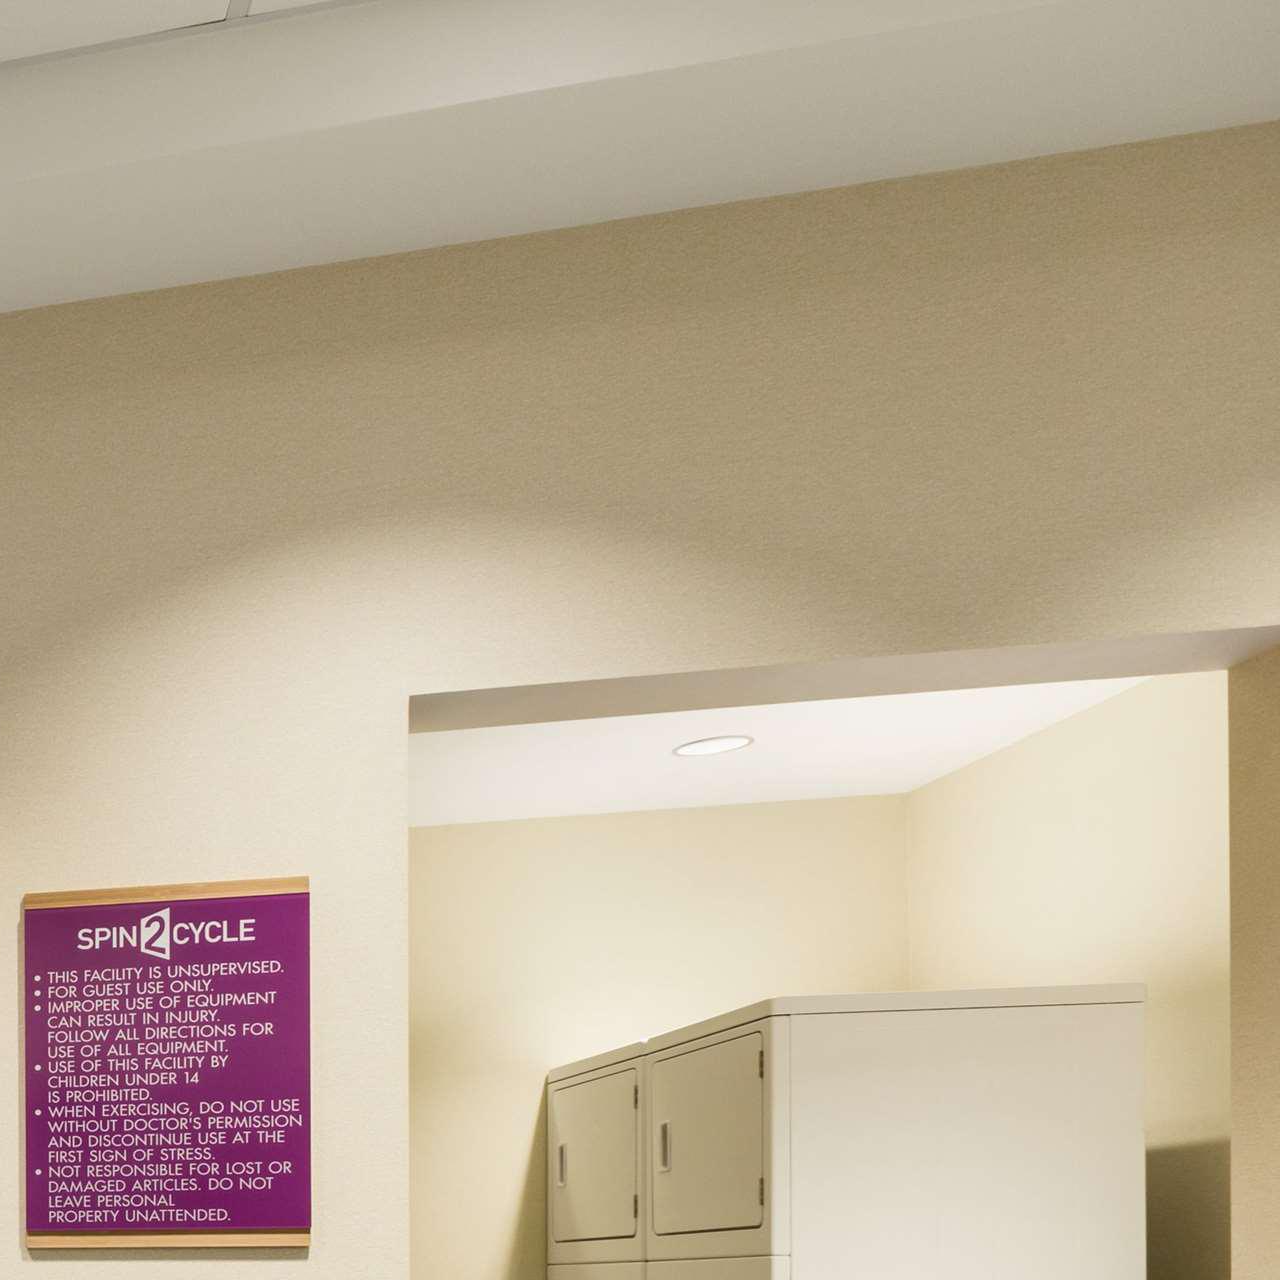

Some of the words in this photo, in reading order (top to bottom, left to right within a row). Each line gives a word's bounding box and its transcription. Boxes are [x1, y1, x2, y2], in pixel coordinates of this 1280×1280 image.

[77, 926, 137, 950] SPIN
[172, 918, 256, 945] CYCLE
[47, 970, 78, 984] THIS
[84, 967, 143, 982] FACILITY
[149, 966, 162, 979] IS
[167, 960, 284, 978] UNSUPERVISED.
[48, 985, 77, 998] FOR
[83, 982, 131, 997] GUEST
[136, 981, 164, 995] USE
[170, 979, 214, 993] ONLY.
[48, 998, 120, 1014] IMPROPER
[126, 996, 153, 1010] USE
[159, 995, 181, 1009] OF
[187, 991, 277, 1008] EQUIPMENT
[47, 1015, 81, 1029] CAN
[88, 1012, 137, 1027] RESULT
[143, 1012, 159, 1024] IN
[165, 1009, 220, 1023] INJURY.
[48, 1029, 110, 1043] FOLLOW
[115, 1028, 140, 1041] ALL
[145, 1023, 236, 1040] DIRECTIONS
[243, 1022, 274, 1036] FOR
[48, 1045, 75, 1059] USE
[80, 1044, 101, 1057] OF
[107, 1043, 132, 1056] ALL
[137, 1039, 228, 1055] EQUIPMENT.
[48, 1060, 75, 1073] USE
[81, 1059, 102, 1072] OF
[107, 1058, 139, 1071] THIS
[145, 1055, 205, 1070] FACILITY
[211, 1055, 228, 1068] BY
[48, 1074, 119, 1088] CHILDREN
[125, 1072, 177, 1086] UNDER
[184, 1071, 199, 1084] 14
[48, 1090, 60, 1103] IS
[66, 1088, 152, 1102] PROHIBITED.
[48, 1105, 95, 1117] WHEN
[102, 1102, 193, 1119] EXERCISING,
[200, 1101, 224, 1114] DO
[230, 1099, 265, 1113] NOT
[271, 1098, 299, 1112] USE
[48, 1119, 118, 1132] WITHOUT
[124, 1117, 201, 1131] DOCTOR'S
[208, 1114, 302, 1129] PERMISSION
[48, 1135, 82, 1148] AND
[88, 1132, 191, 1147] DISCONTINUE
[198, 1131, 226, 1145] USE
[232, 1131, 251, 1143] AT
[257, 1130, 285, 1143] THE
[48, 1150, 83, 1163] FIRST
[89, 1149, 127, 1162] SIGN
[133, 1148, 154, 1161] OF
[160, 1147, 215, 1161] STRESS.
[49, 1165, 81, 1178] NOT
[87, 1163, 182, 1177] RESPONSIBLE
[189, 1162, 219, 1175] FOR
[226, 1161, 263, 1174] LOST
[268, 1161, 292, 1174] OR
[49, 1179, 126, 1193] DAMAGED
[132, 1178, 201, 1191] ARTICLES.
[209, 1177, 233, 1190] DO
[239, 1177, 274, 1189] NOT
[49, 1195, 91, 1208] LEAVE
[97, 1194, 175, 1207] PERSONAL
[49, 1210, 119, 1222] PROPERTY
[125, 1209, 231, 1222] UNATTENDED.
